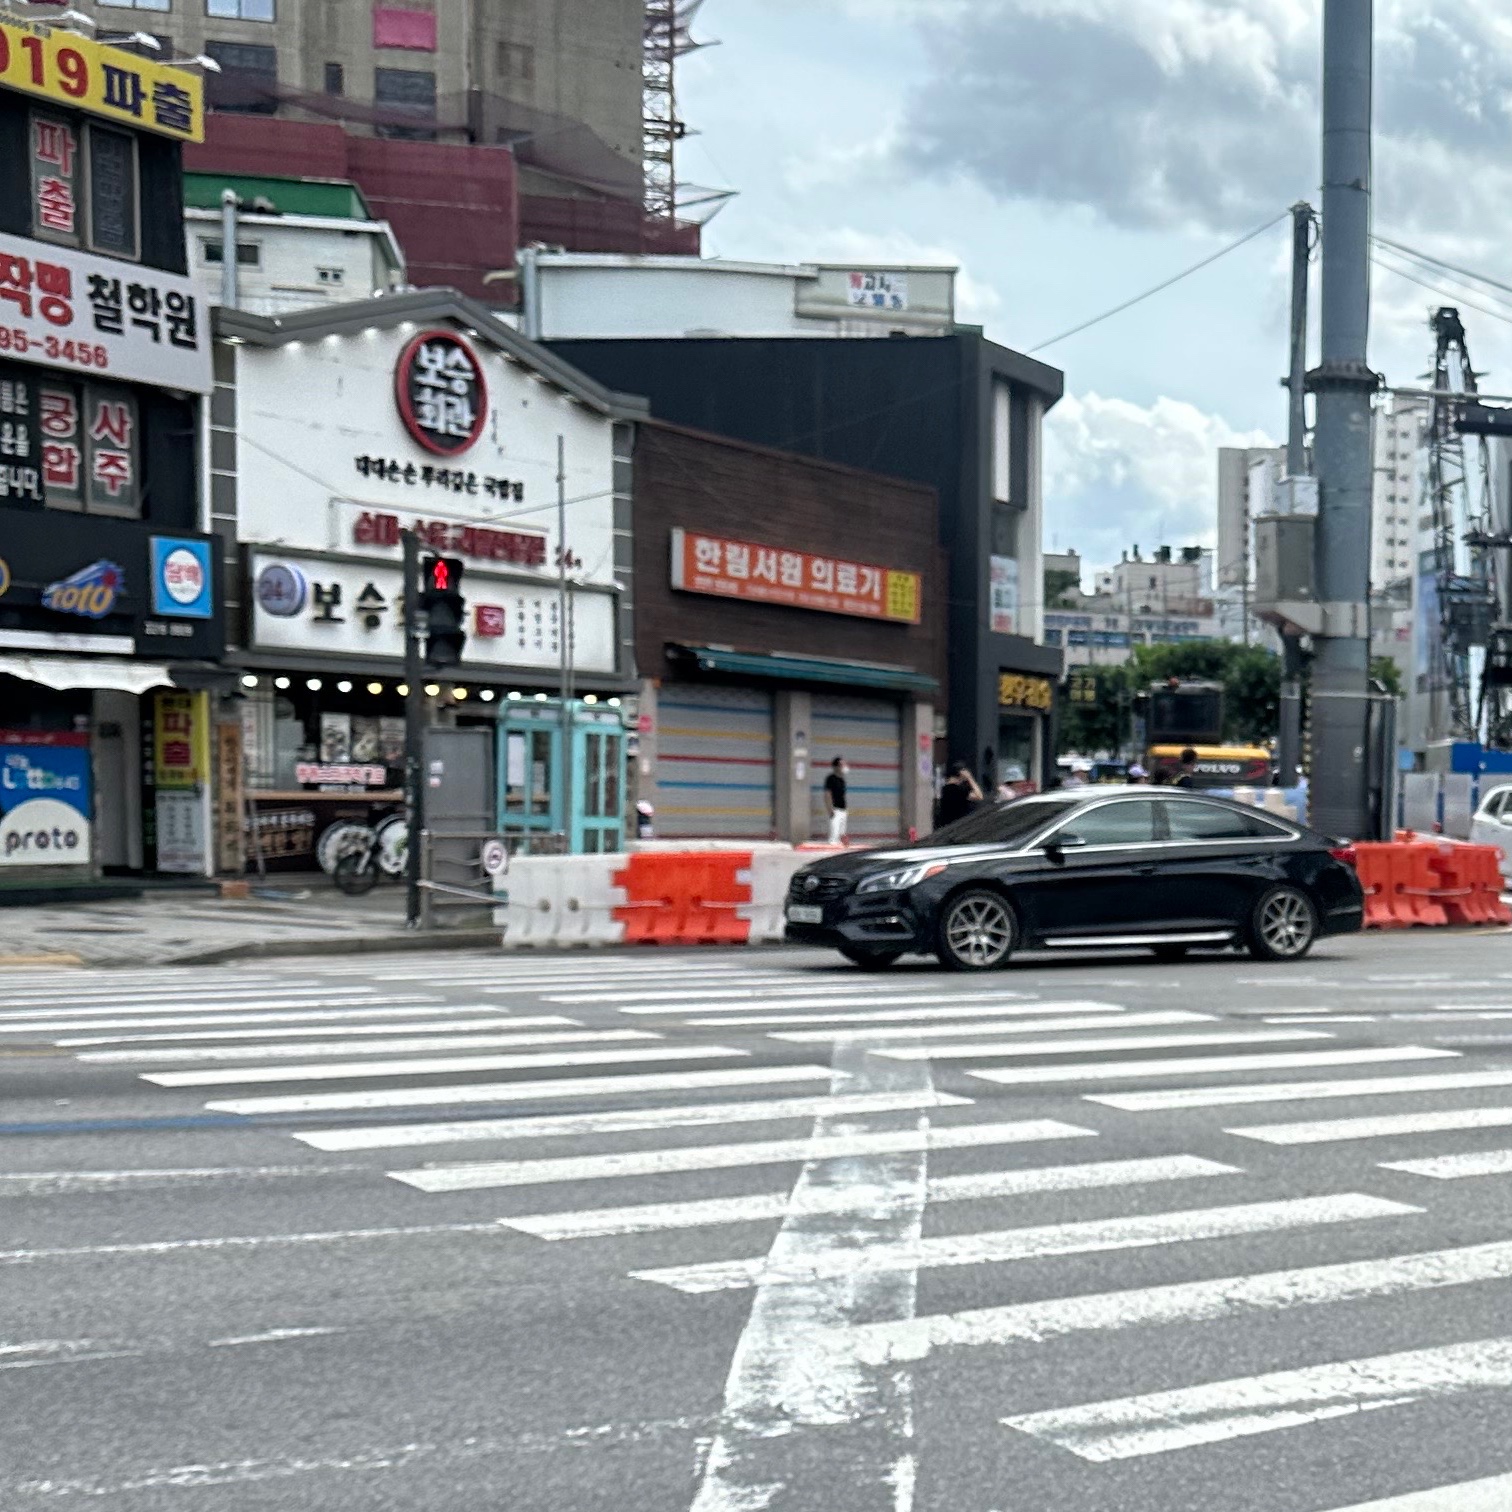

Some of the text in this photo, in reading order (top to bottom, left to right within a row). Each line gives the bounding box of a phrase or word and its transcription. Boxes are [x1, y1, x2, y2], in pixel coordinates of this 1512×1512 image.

[102, 63, 193, 134] 파출
[35, 118, 77, 233] 파출
[0, 253, 199, 350] 작명 철학원
[414, 344, 475, 395] 보승
[40, 390, 80, 487] 궁합
[414, 387, 476, 437] 회관
[91, 401, 132, 495] 사주
[810, 557, 882, 601] 의료기
[5, 826, 79, 857] proto
